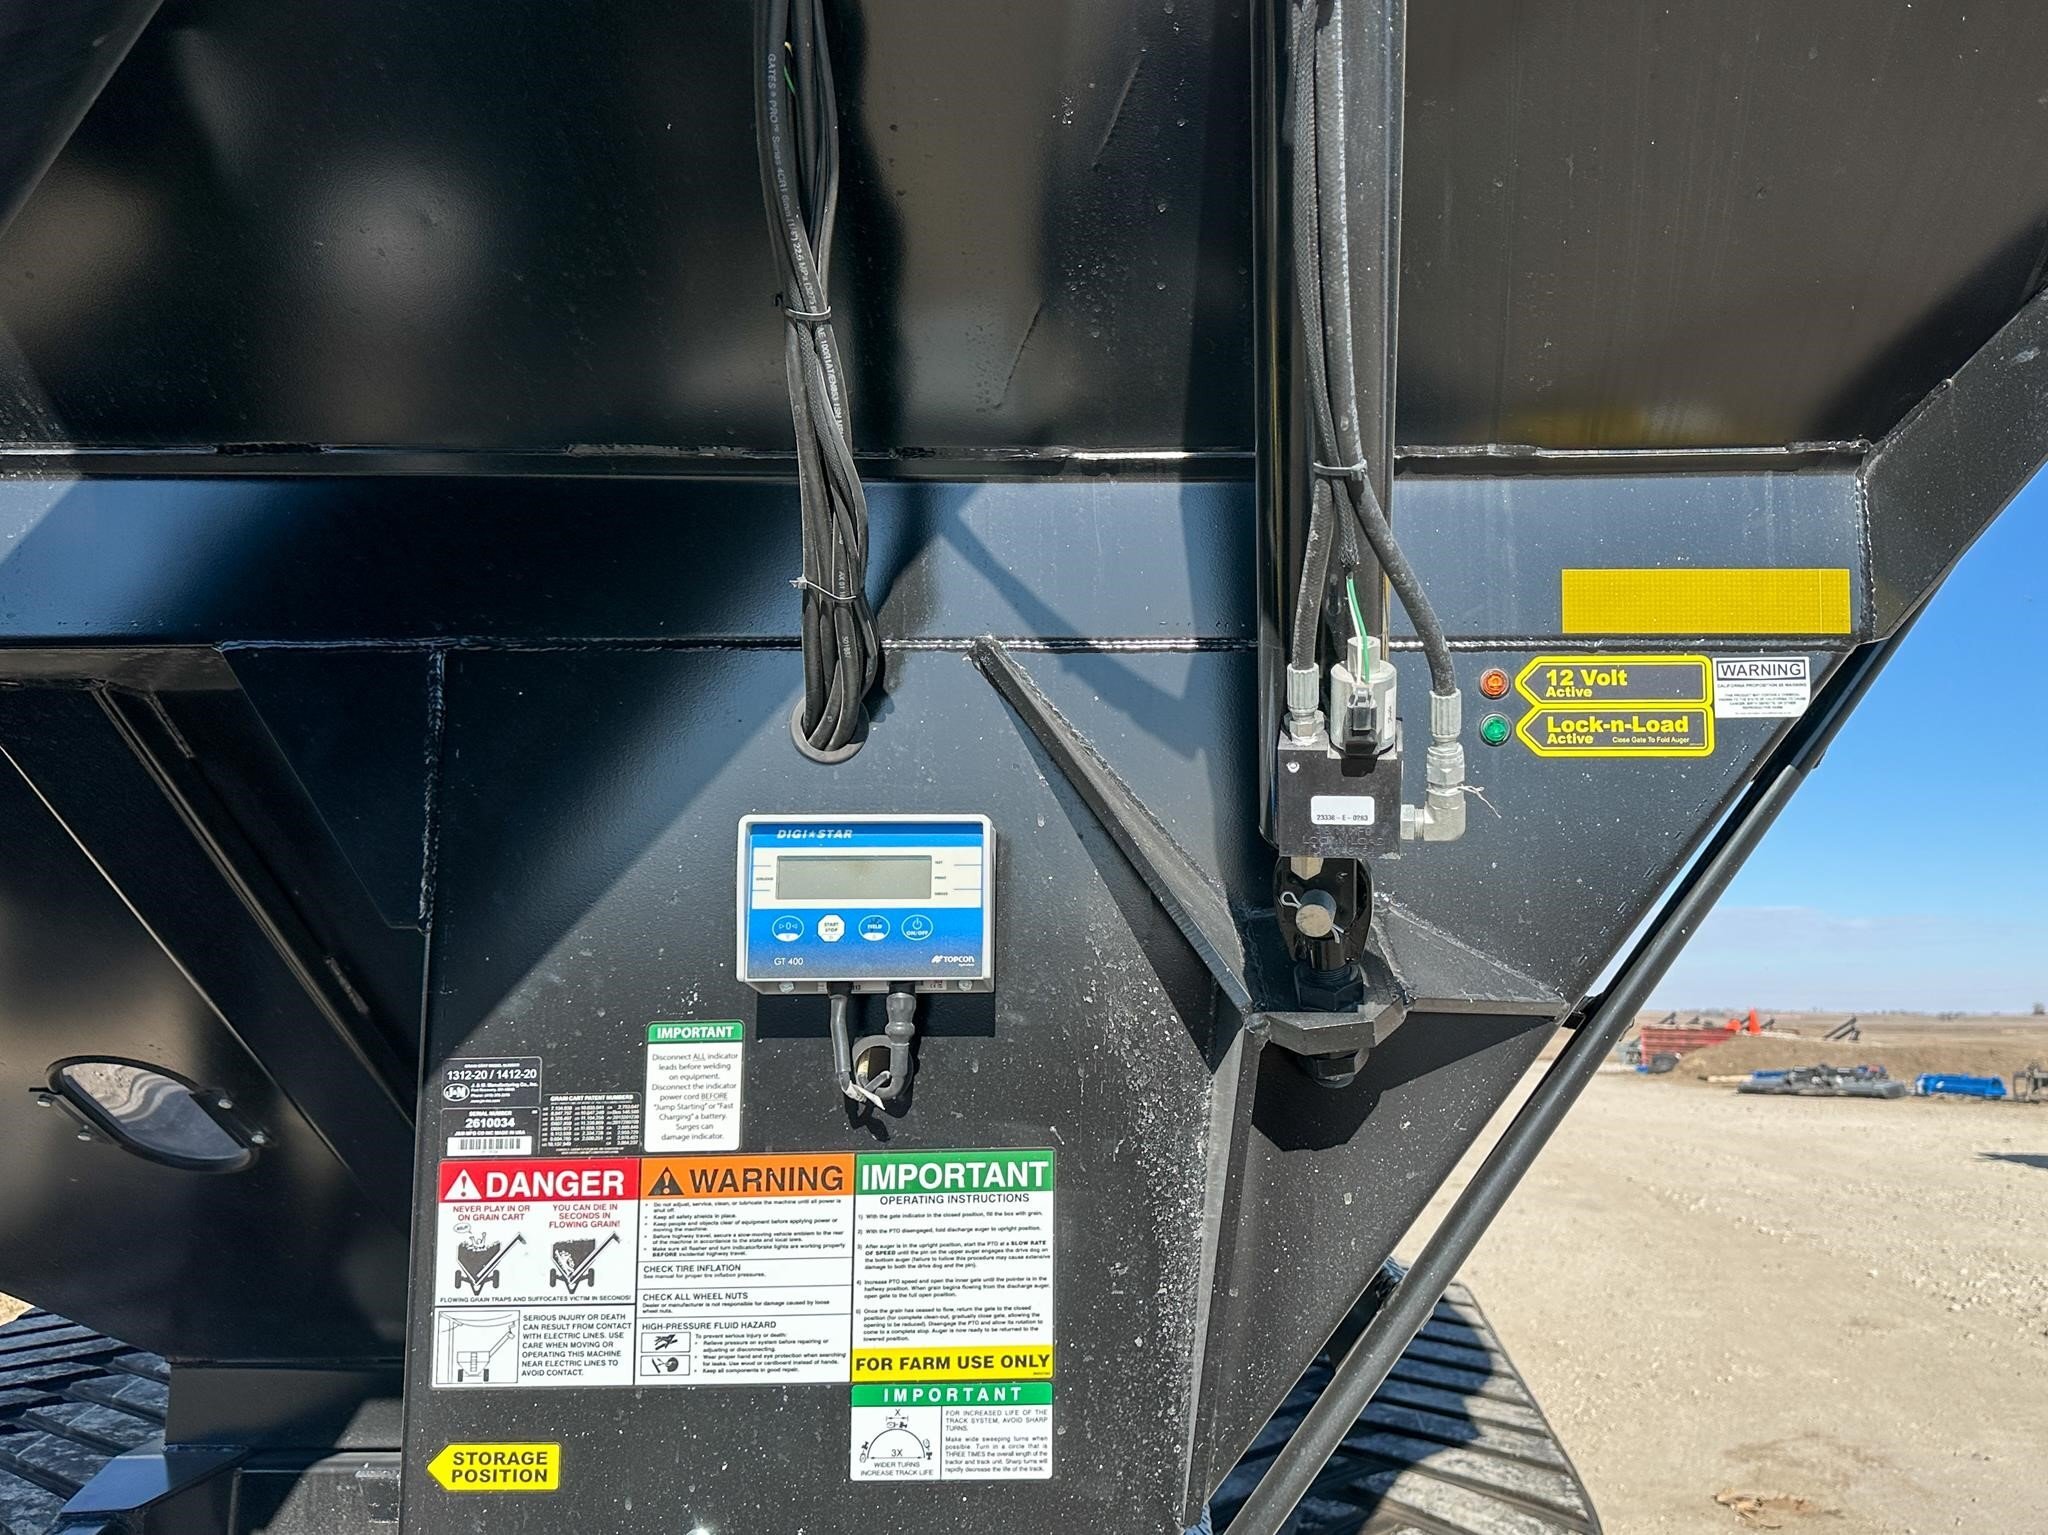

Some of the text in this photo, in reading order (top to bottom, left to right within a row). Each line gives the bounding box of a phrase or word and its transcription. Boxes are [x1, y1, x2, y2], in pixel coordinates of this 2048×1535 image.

[1721, 663, 1801, 677] WARNING
[1546, 669, 1627, 687] 12 Volt
[1546, 686, 1592, 697] Active
[1548, 716, 1688, 734] Lock-n-Load
[1547, 733, 1594, 744] Active
[1671, 737, 1690, 745] Auger
[774, 957, 804, 967] GT 400
[942, 956, 975, 964] TOPCON
[657, 1026, 734, 1039] IMPORTANT
[447, 1069, 537, 1081] 1312-20 / 1412-20
[465, 1117, 516, 1129] 2610034
[689, 1166, 843, 1194] WARNING
[862, 1161, 1049, 1191] IMPORTANT
[486, 1170, 624, 1198] DANGER
[880, 1193, 1029, 1205] OPERATING INSTRUCTIONS
[453, 1205, 481, 1213] NEVER
[553, 1204, 571, 1212] YOU
[473, 1213, 499, 1221] GRAIN
[501, 1213, 525, 1221] CART
[559, 1212, 600, 1220] SECONDS
[549, 1220, 620, 1229] FLOWING GRAIN!
[643, 1265, 673, 1273] CHECK
[697, 1264, 741, 1272] INFLATION
[643, 1293, 672, 1301] CHECK
[693, 1292, 723, 1300] WHEEL
[725, 1292, 748, 1300] NUTS
[523, 1314, 557, 1322] SERIOUS
[596, 1322, 632, 1330] CONTACT
[642, 1322, 711, 1331] HIGH-PRESSURE
[741, 1321, 776, 1329] HAZARD
[544, 1332, 581, 1340] ELECTRIC
[856, 1354, 1050, 1371] FOR FARM USE ONLY
[521, 1369, 545, 1377] AVOID
[884, 1386, 1021, 1403] IMPORTANT
[895, 1409, 903, 1417] X
[890, 1449, 905, 1458] 3X
[453, 1452, 548, 1466] STORAGE
[452, 1469, 547, 1483] POSITION
